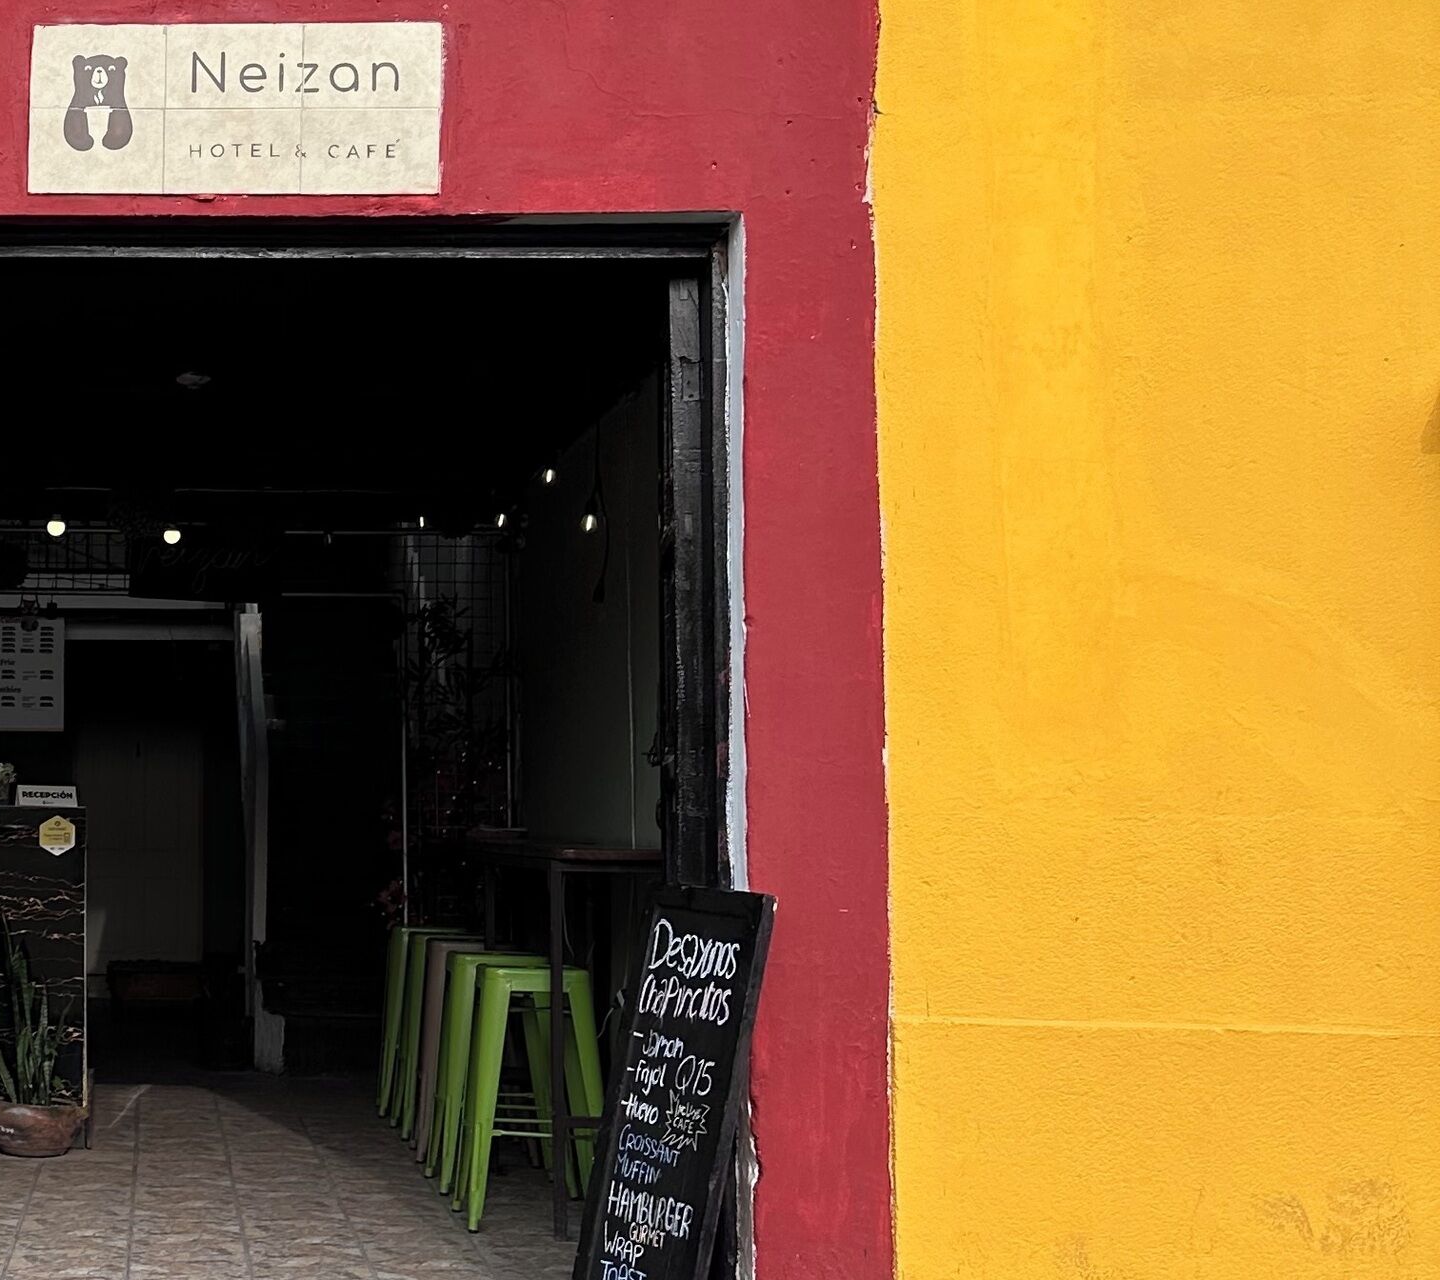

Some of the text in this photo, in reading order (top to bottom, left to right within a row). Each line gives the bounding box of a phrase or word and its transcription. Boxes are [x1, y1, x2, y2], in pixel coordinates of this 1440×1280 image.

[191, 51, 400, 93] Neizan
[189, 138, 401, 159] HOTEL & CAFÉ
[21, 790, 73, 800] RECEPCIÓN
[674, 1054, 716, 1097] Q15
[613, 1153, 662, 1185] MUFFIN
[607, 1180, 694, 1241] HAMBURGER
[603, 1219, 645, 1268] WRAP
